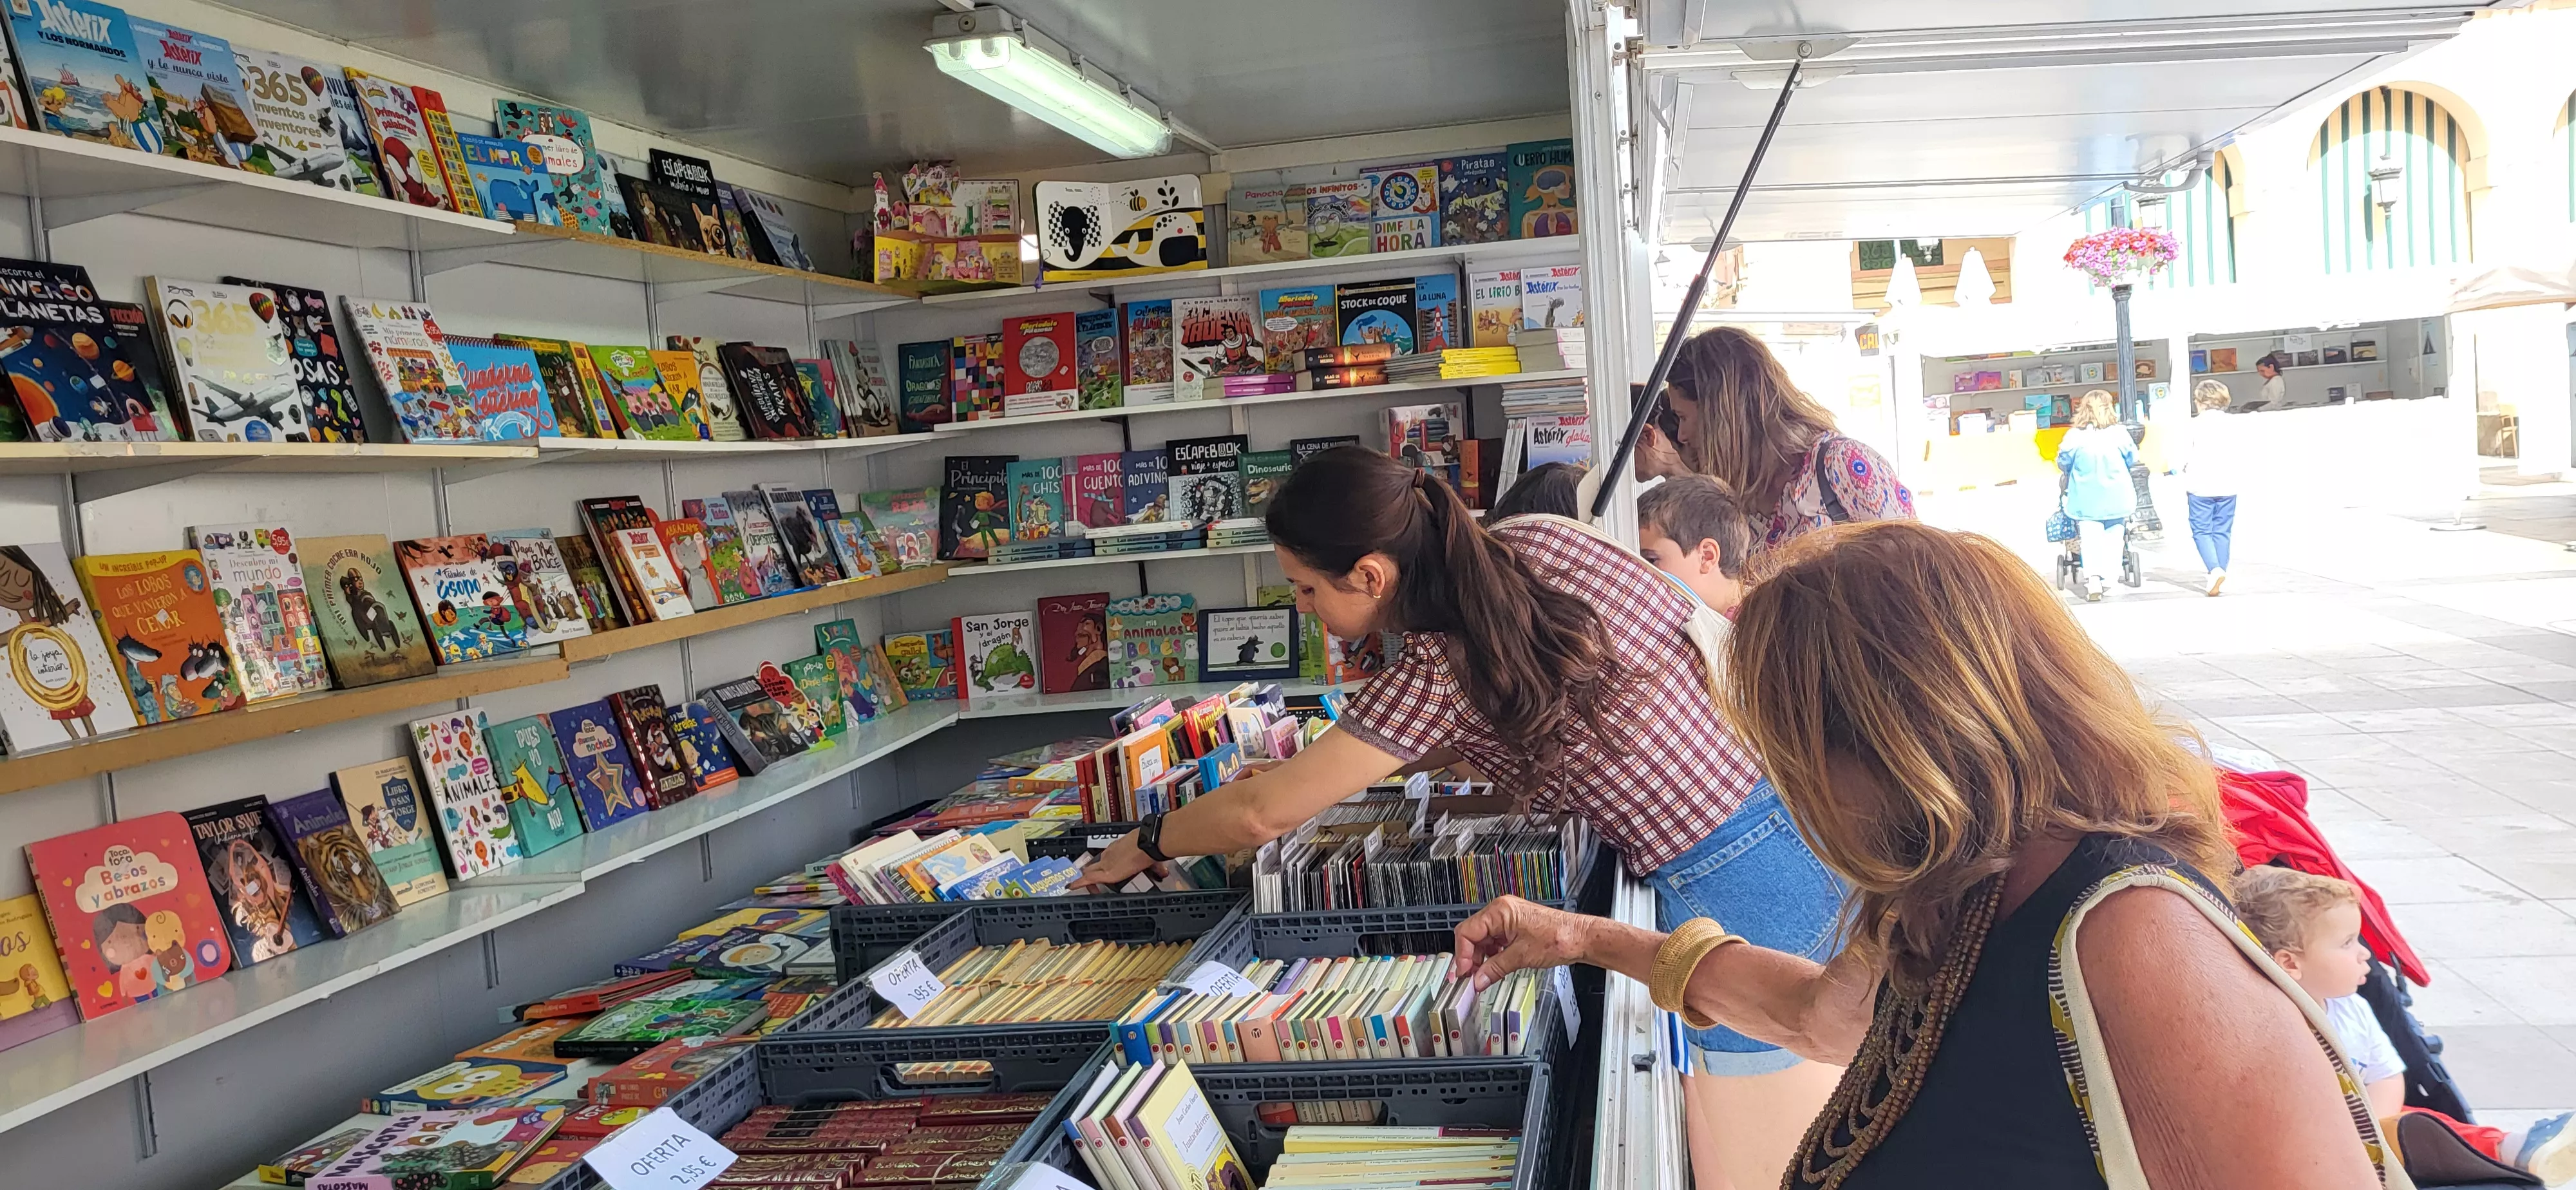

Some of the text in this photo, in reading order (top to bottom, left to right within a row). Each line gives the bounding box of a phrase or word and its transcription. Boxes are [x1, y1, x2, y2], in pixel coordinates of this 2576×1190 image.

[37, 30, 126, 58] Y LOS NORMANDOS
[160, 39, 202, 66] Astérix
[147, 57, 229, 84] y lo nunca visto
[247, 66, 307, 107] 365
[252, 99, 316, 123] Inventos e
[256, 116, 322, 138] inventores
[465, 144, 486, 162] EL
[555, 144, 569, 153] libro
[1461, 158, 1495, 170] Piratas
[1513, 150, 1573, 167] CUERPO HUM
[662, 159, 711, 184] ESCAPEBOOK
[1245, 189, 1283, 200] Panocha
[1410, 219, 1425, 231] LA
[1377, 232, 1426, 252] HORA
[35, 270, 45, 279] el
[1551, 267, 1580, 278] Astérix
[1428, 292, 1446, 301] LUNA
[1475, 289, 1485, 299] EL
[1489, 285, 1511, 299] LIRIO
[1526, 281, 1559, 294] Astérix
[0, 299, 104, 323] LANETAS
[1341, 298, 1368, 310] STOCK
[1377, 294, 1408, 307] COQUE
[384, 335, 429, 348] números
[290, 357, 340, 385] OSAS
[1533, 426, 1566, 446] Astérix
[1175, 442, 1242, 461] ESCAPEBOOK
[1307, 442, 1320, 451] CENA
[961, 461, 969, 471] El
[1191, 458, 1235, 473] viaje espacio
[1247, 463, 1293, 475] Dinosaurio
[1084, 473, 1123, 490] CUENTO
[1128, 471, 1168, 487] ADIVINA
[509, 540, 534, 558] Papá
[99, 562, 109, 571] UN
[269, 555, 278, 564] mi
[327, 549, 346, 568] COCHE
[344, 548, 359, 559] ERA
[361, 553, 382, 575] ROJO
[232, 565, 281, 583] mundo
[469, 567, 477, 576] de
[115, 573, 171, 600] LOS LOBOS
[437, 578, 482, 603] Esopo
[111, 588, 187, 618] QUE VINIERON A
[137, 610, 185, 636] CENAR
[966, 616, 1030, 634] San Jorge
[1213, 614, 1220, 623] El
[982, 632, 1012, 648] dragón
[42, 648, 62, 663] joya
[37, 661, 68, 675] interior
[716, 679, 762, 701] DINOSAURIOS
[706, 697, 737, 737] DINOSAURIOS
[586, 737, 613, 753] noches!
[528, 749, 542, 768] YO
[386, 784, 408, 797] LIBRO
[444, 773, 501, 805] ANIMALES
[292, 806, 348, 835] Animales
[393, 804, 416, 820] JORGE
[547, 807, 564, 830] NO!
[193, 817, 236, 840] TAYLOR
[236, 809, 263, 829] SWIF
[109, 849, 130, 859] Toca
[109, 855, 133, 867] toca
[100, 864, 147, 885] Besos
[299, 866, 319, 898] Animales
[1023, 869, 1065, 894] Juguemos
[1063, 867, 1077, 877] con
[91, 875, 166, 909] y abrazos
[888, 958, 921, 986] OFERTA
[926, 980, 937, 992] €
[1209, 970, 1242, 997] OFERTA
[1175, 1113, 1184, 1125] Juan
[1182, 1103, 1191, 1116] Carlos
[1182, 1111, 1211, 1153] Juntacadáveres
[323, 1115, 422, 1178] MASCOTAS
[630, 1133, 692, 1176] OFERTA
[670, 1155, 717, 1185] 2,95 €
